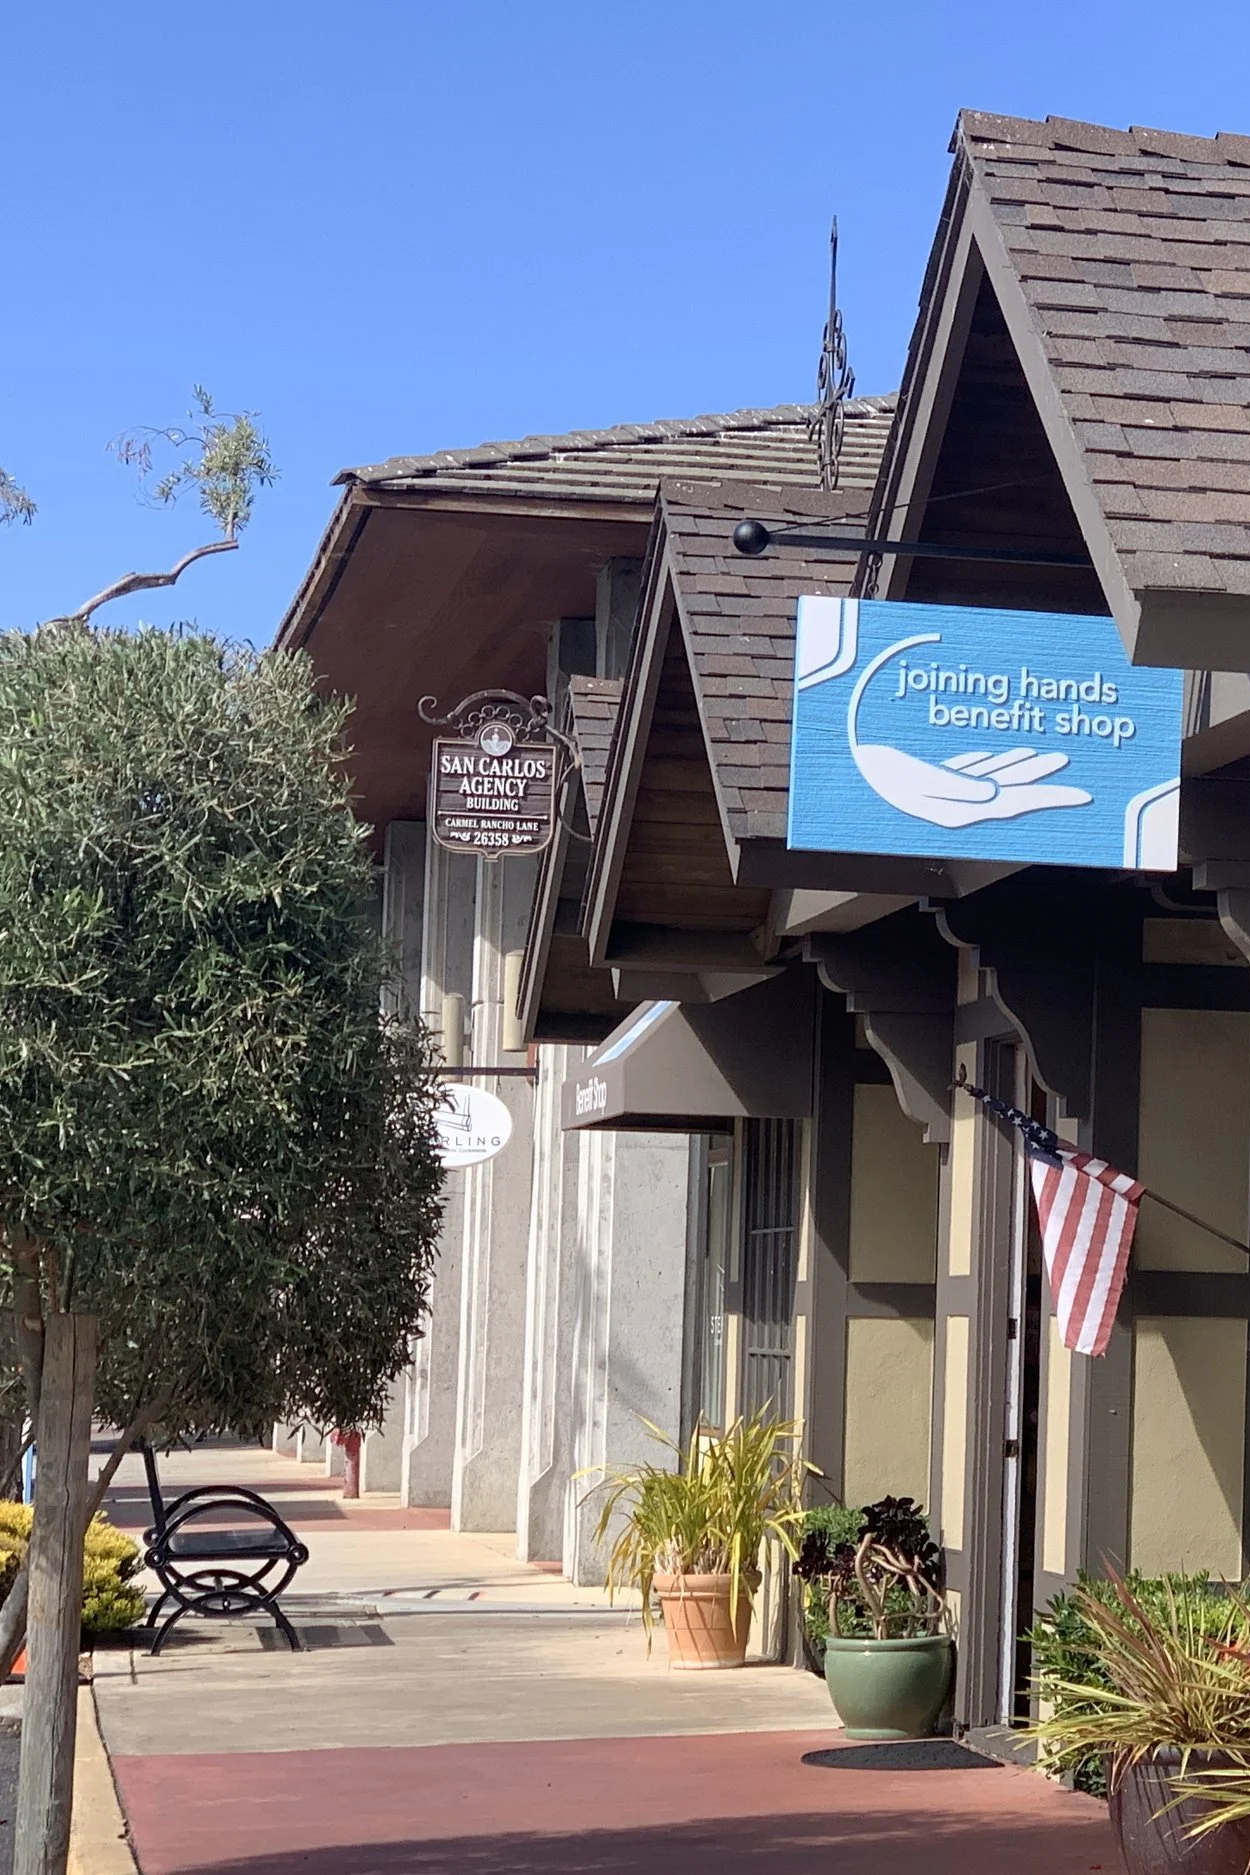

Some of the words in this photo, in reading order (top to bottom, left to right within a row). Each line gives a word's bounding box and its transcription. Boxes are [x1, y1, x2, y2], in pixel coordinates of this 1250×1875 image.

[895, 659, 1009, 704] joining
[1020, 666, 1118, 703] hands
[928, 694, 1045, 732] benefit
[1056, 703, 1136, 747] shop
[441, 755, 475, 774] SAN
[478, 757, 546, 778] CARLOS
[459, 776, 527, 796] AGENCY
[466, 797, 519, 811] BUILDING
[445, 818, 479, 829] CARMEL
[481, 819, 514, 830] RANCHO
[516, 821, 539, 831] LANE
[473, 831, 509, 846] 26358
[593, 1076, 607, 1116] Shop
